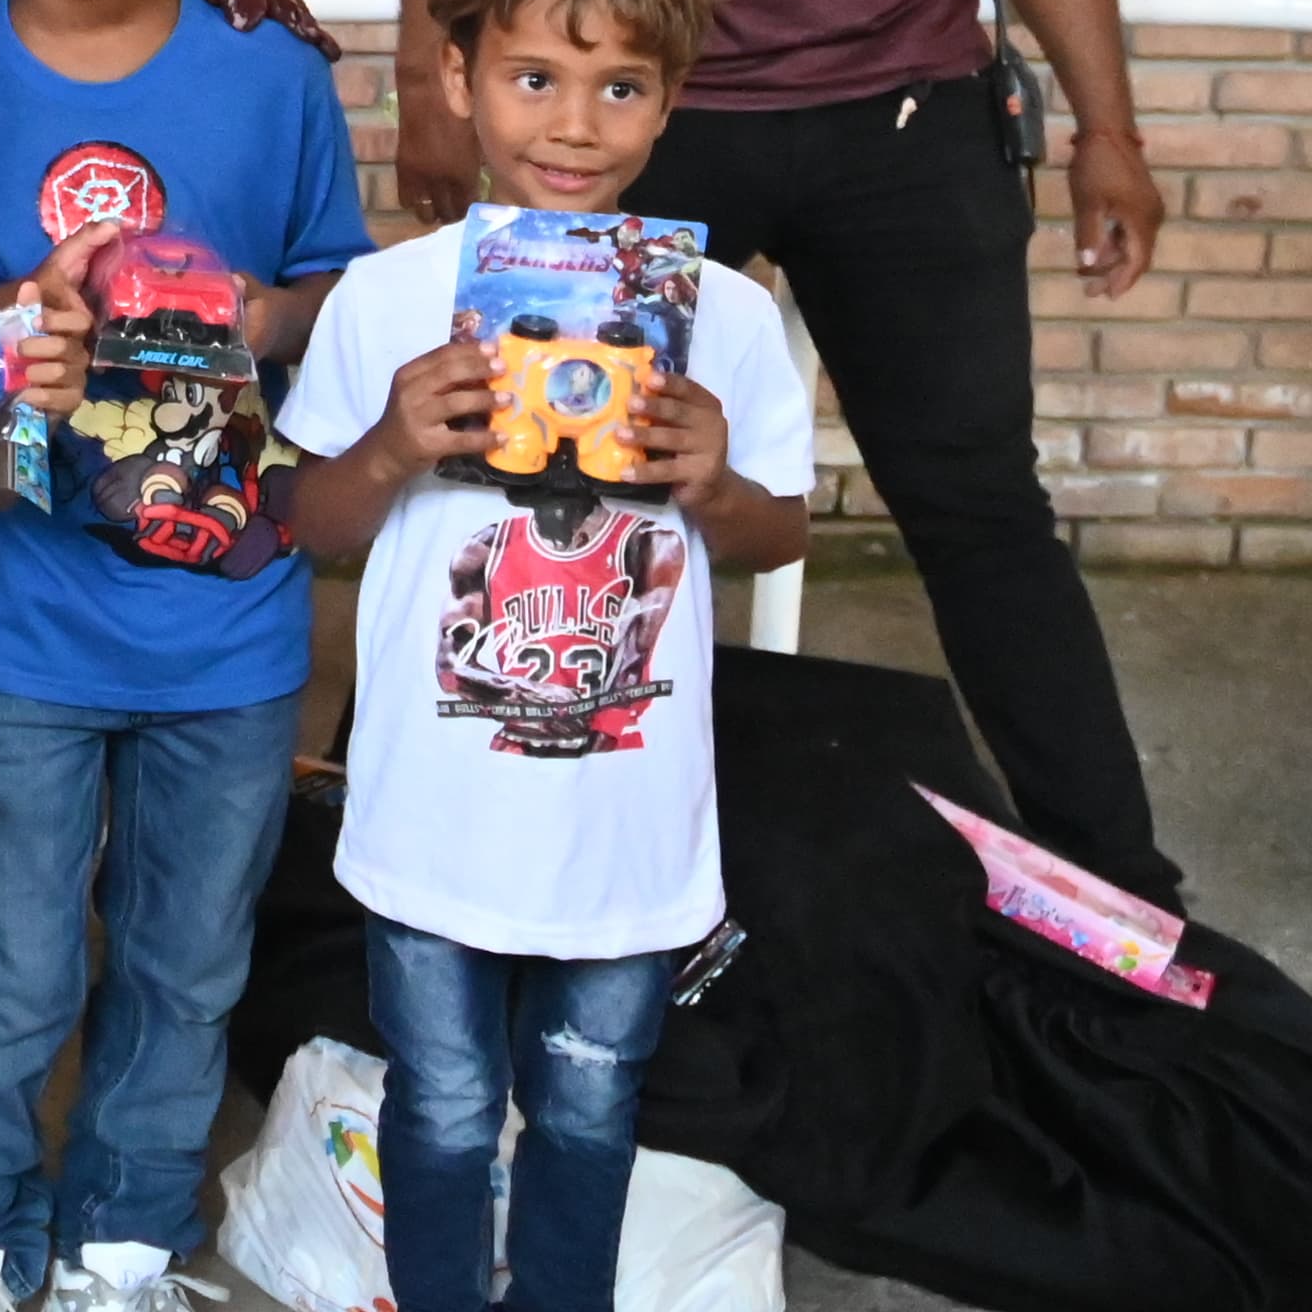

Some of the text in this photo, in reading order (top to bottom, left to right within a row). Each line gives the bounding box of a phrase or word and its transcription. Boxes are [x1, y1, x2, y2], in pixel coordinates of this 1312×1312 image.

[129, 349, 209, 369] MODEL CAR
[502, 585, 625, 646] BULLS
[514, 643, 607, 700] 23
